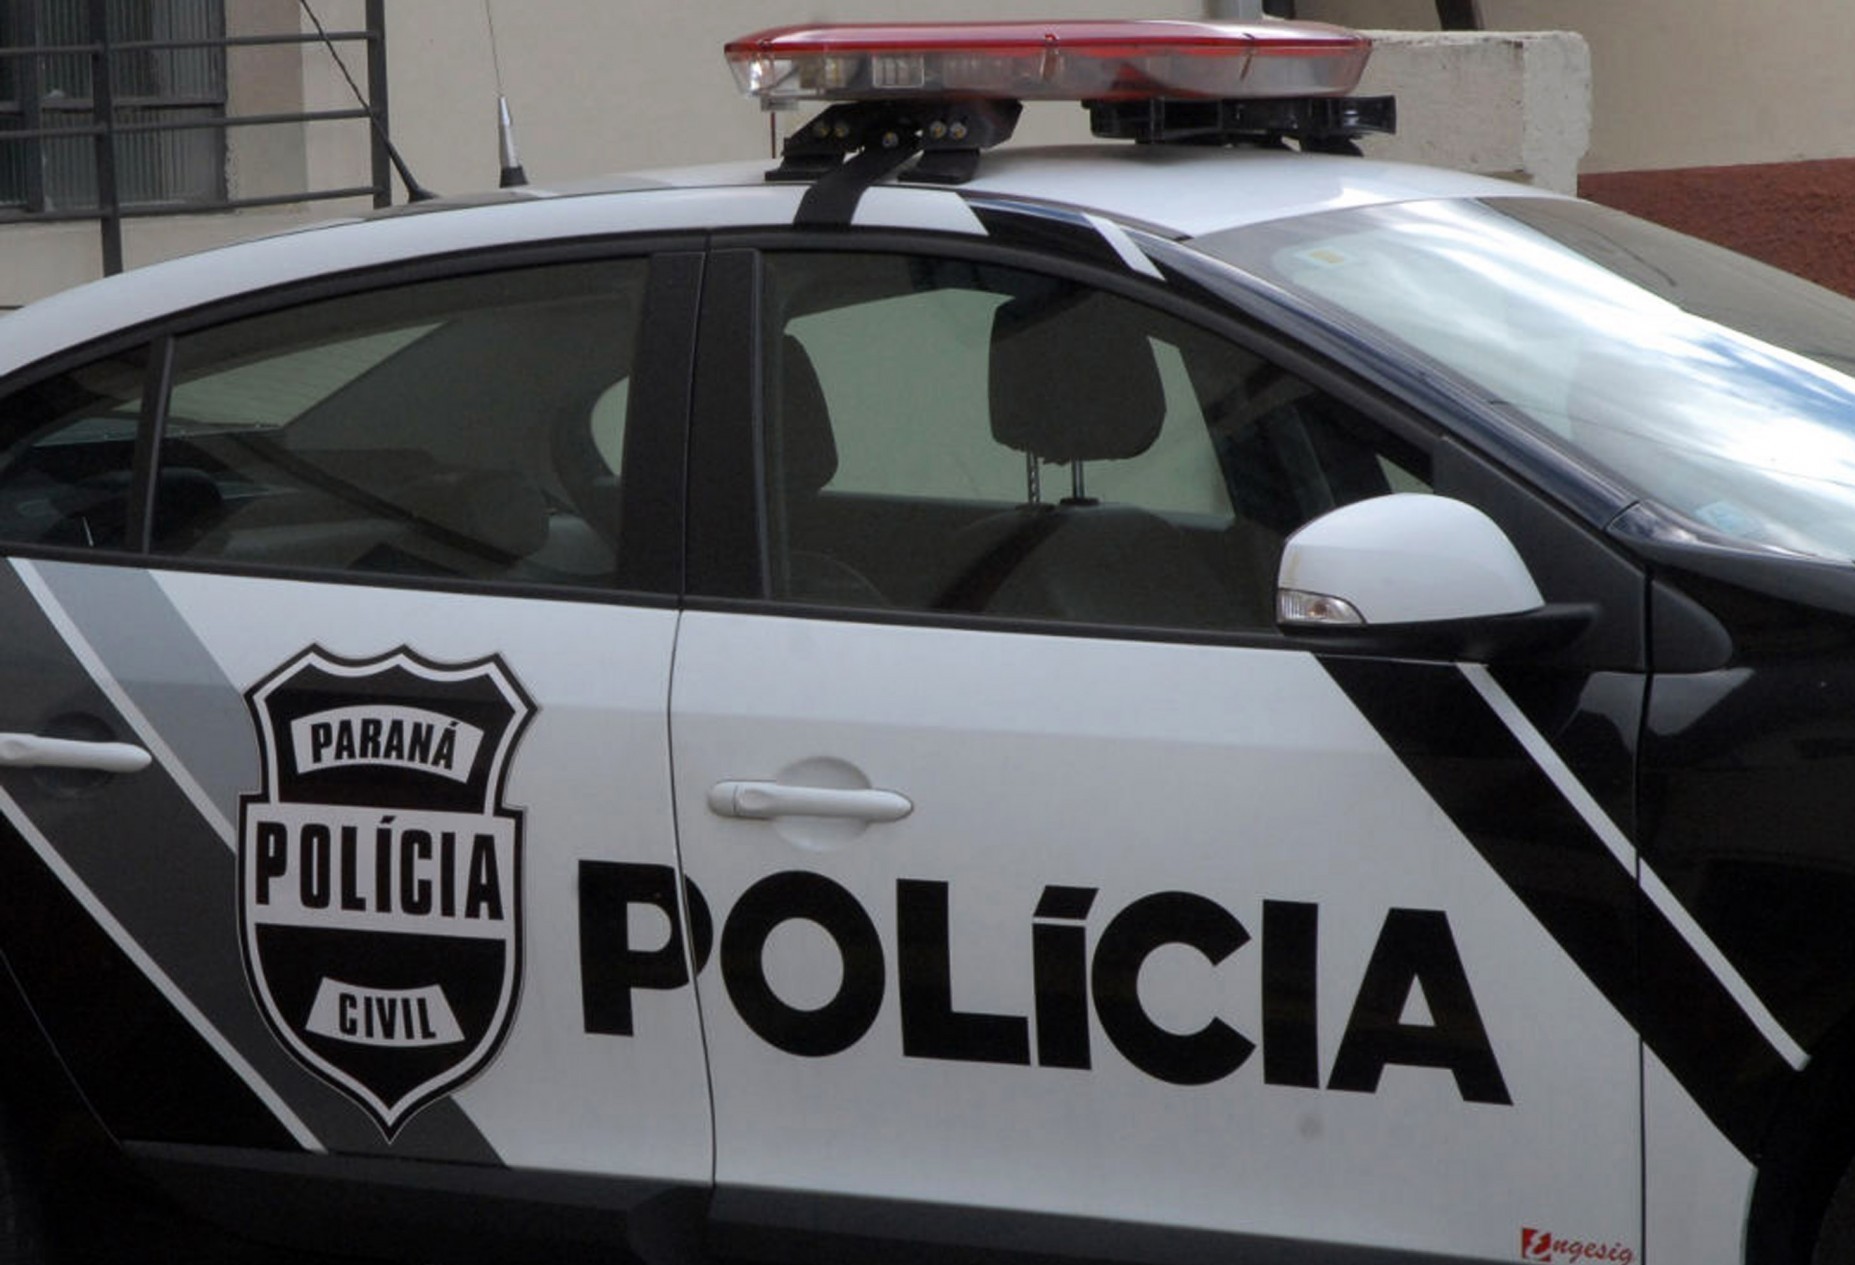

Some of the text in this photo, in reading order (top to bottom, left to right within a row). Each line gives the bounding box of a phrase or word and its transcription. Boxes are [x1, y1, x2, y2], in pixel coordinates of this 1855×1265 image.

[310, 718, 460, 771] PARANÁ
[255, 815, 504, 921] POLÍCIA
[338, 992, 437, 1041] CIVIL
[578, 859, 1514, 1106] POLÍCIA
